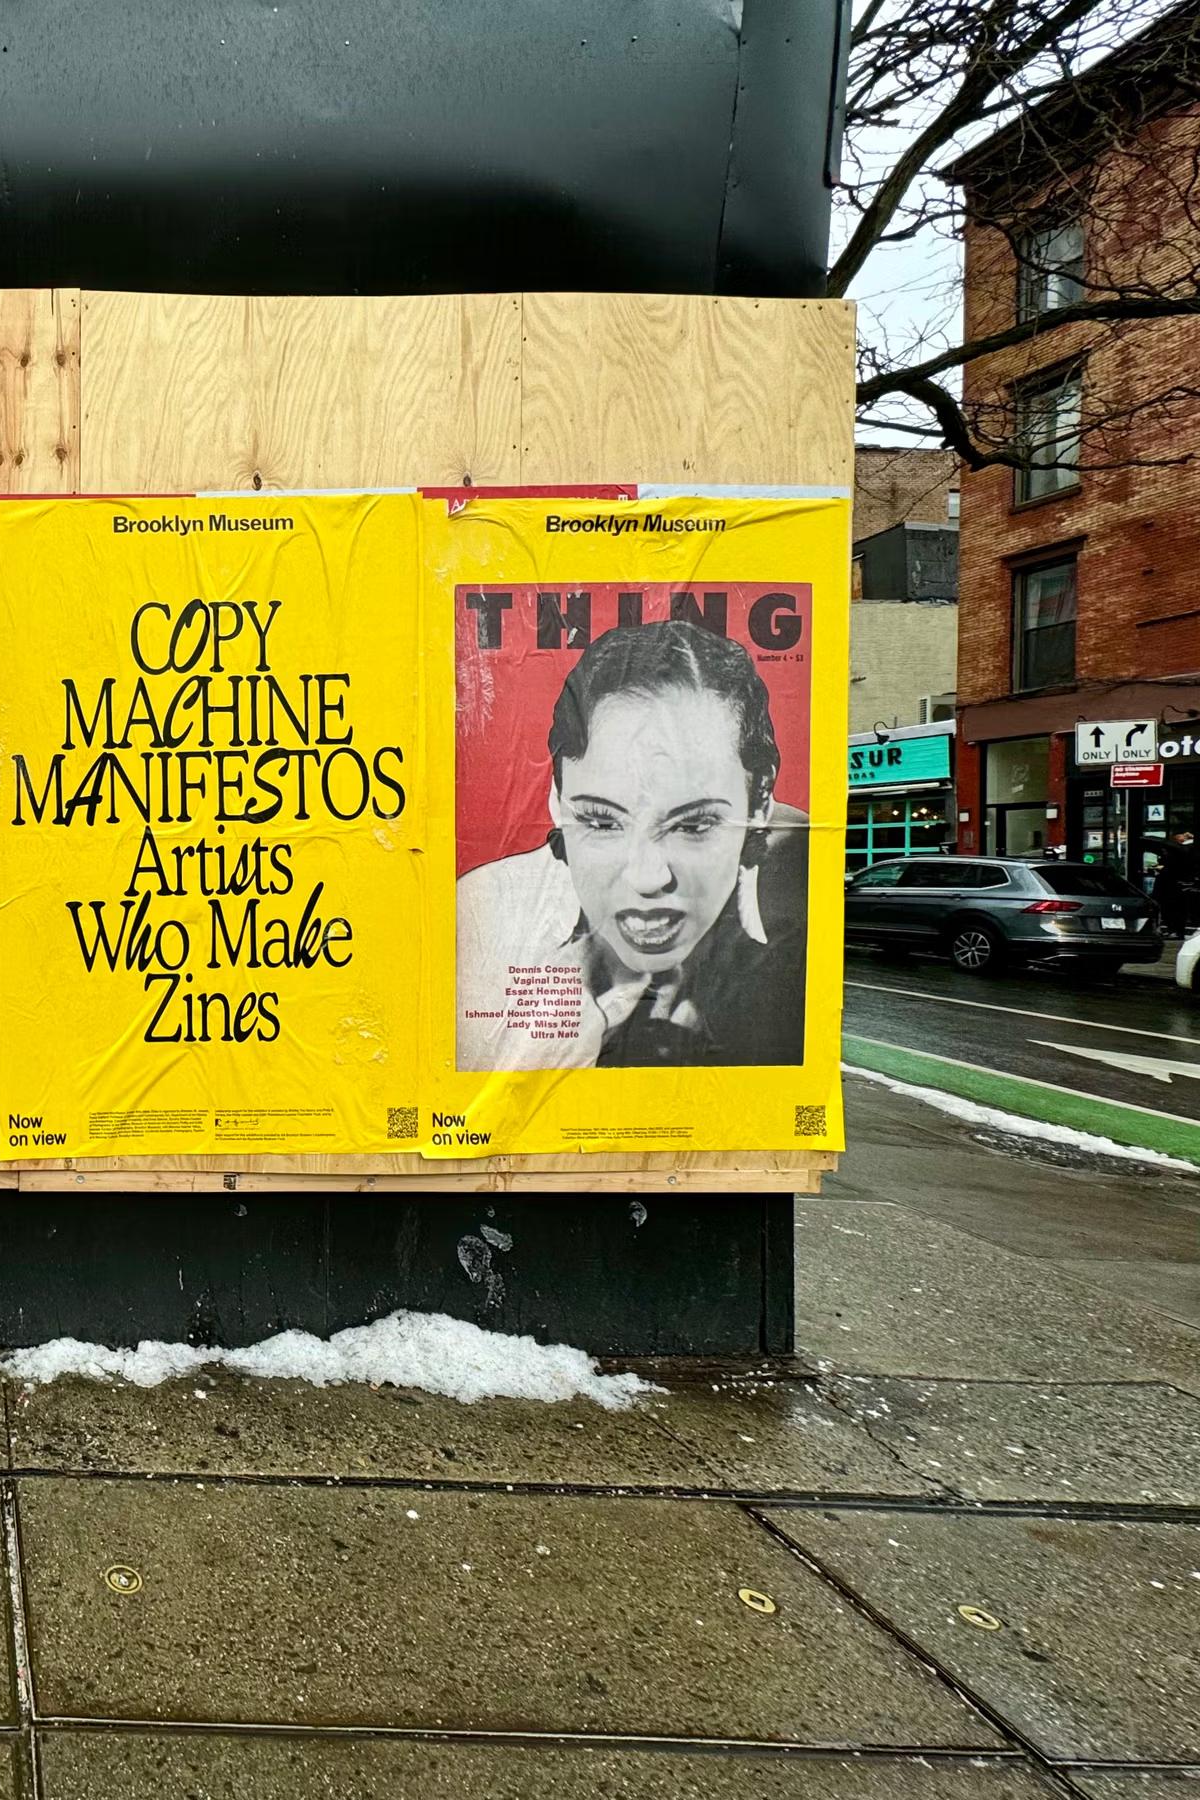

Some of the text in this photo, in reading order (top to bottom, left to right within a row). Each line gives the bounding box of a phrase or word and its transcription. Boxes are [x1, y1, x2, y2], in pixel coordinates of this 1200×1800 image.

[113, 514, 294, 536] Brooklyn Museum
[546, 514, 726, 536] Brooklyn Museum
[466, 591, 802, 651] THING
[130, 599, 282, 674] COPY
[61, 673, 354, 749] MACHINE
[1082, 751, 1111, 760] ONLY
[1123, 749, 1152, 758] ONLY
[11, 746, 406, 827] MANIFESTOS
[124, 824, 294, 897] Artists
[65, 882, 353, 972] Who Make
[508, 965, 582, 975] Dennis Cooper
[513, 976, 582, 986] Vaginal Davis
[505, 987, 583, 997] Essex Hemphill
[143, 973, 281, 1043] Zines
[517, 998, 582, 1008] Gary Indiana
[465, 1009, 582, 1019] Ishmael Houston-Jones
[507, 1020, 580, 1030] Lady Miss Kier
[531, 1031, 555, 1039] Ultra
[8, 1114, 43, 1129] Now
[432, 1112, 466, 1128] Now
[9, 1131, 67, 1147] on view
[432, 1130, 491, 1145] on view
